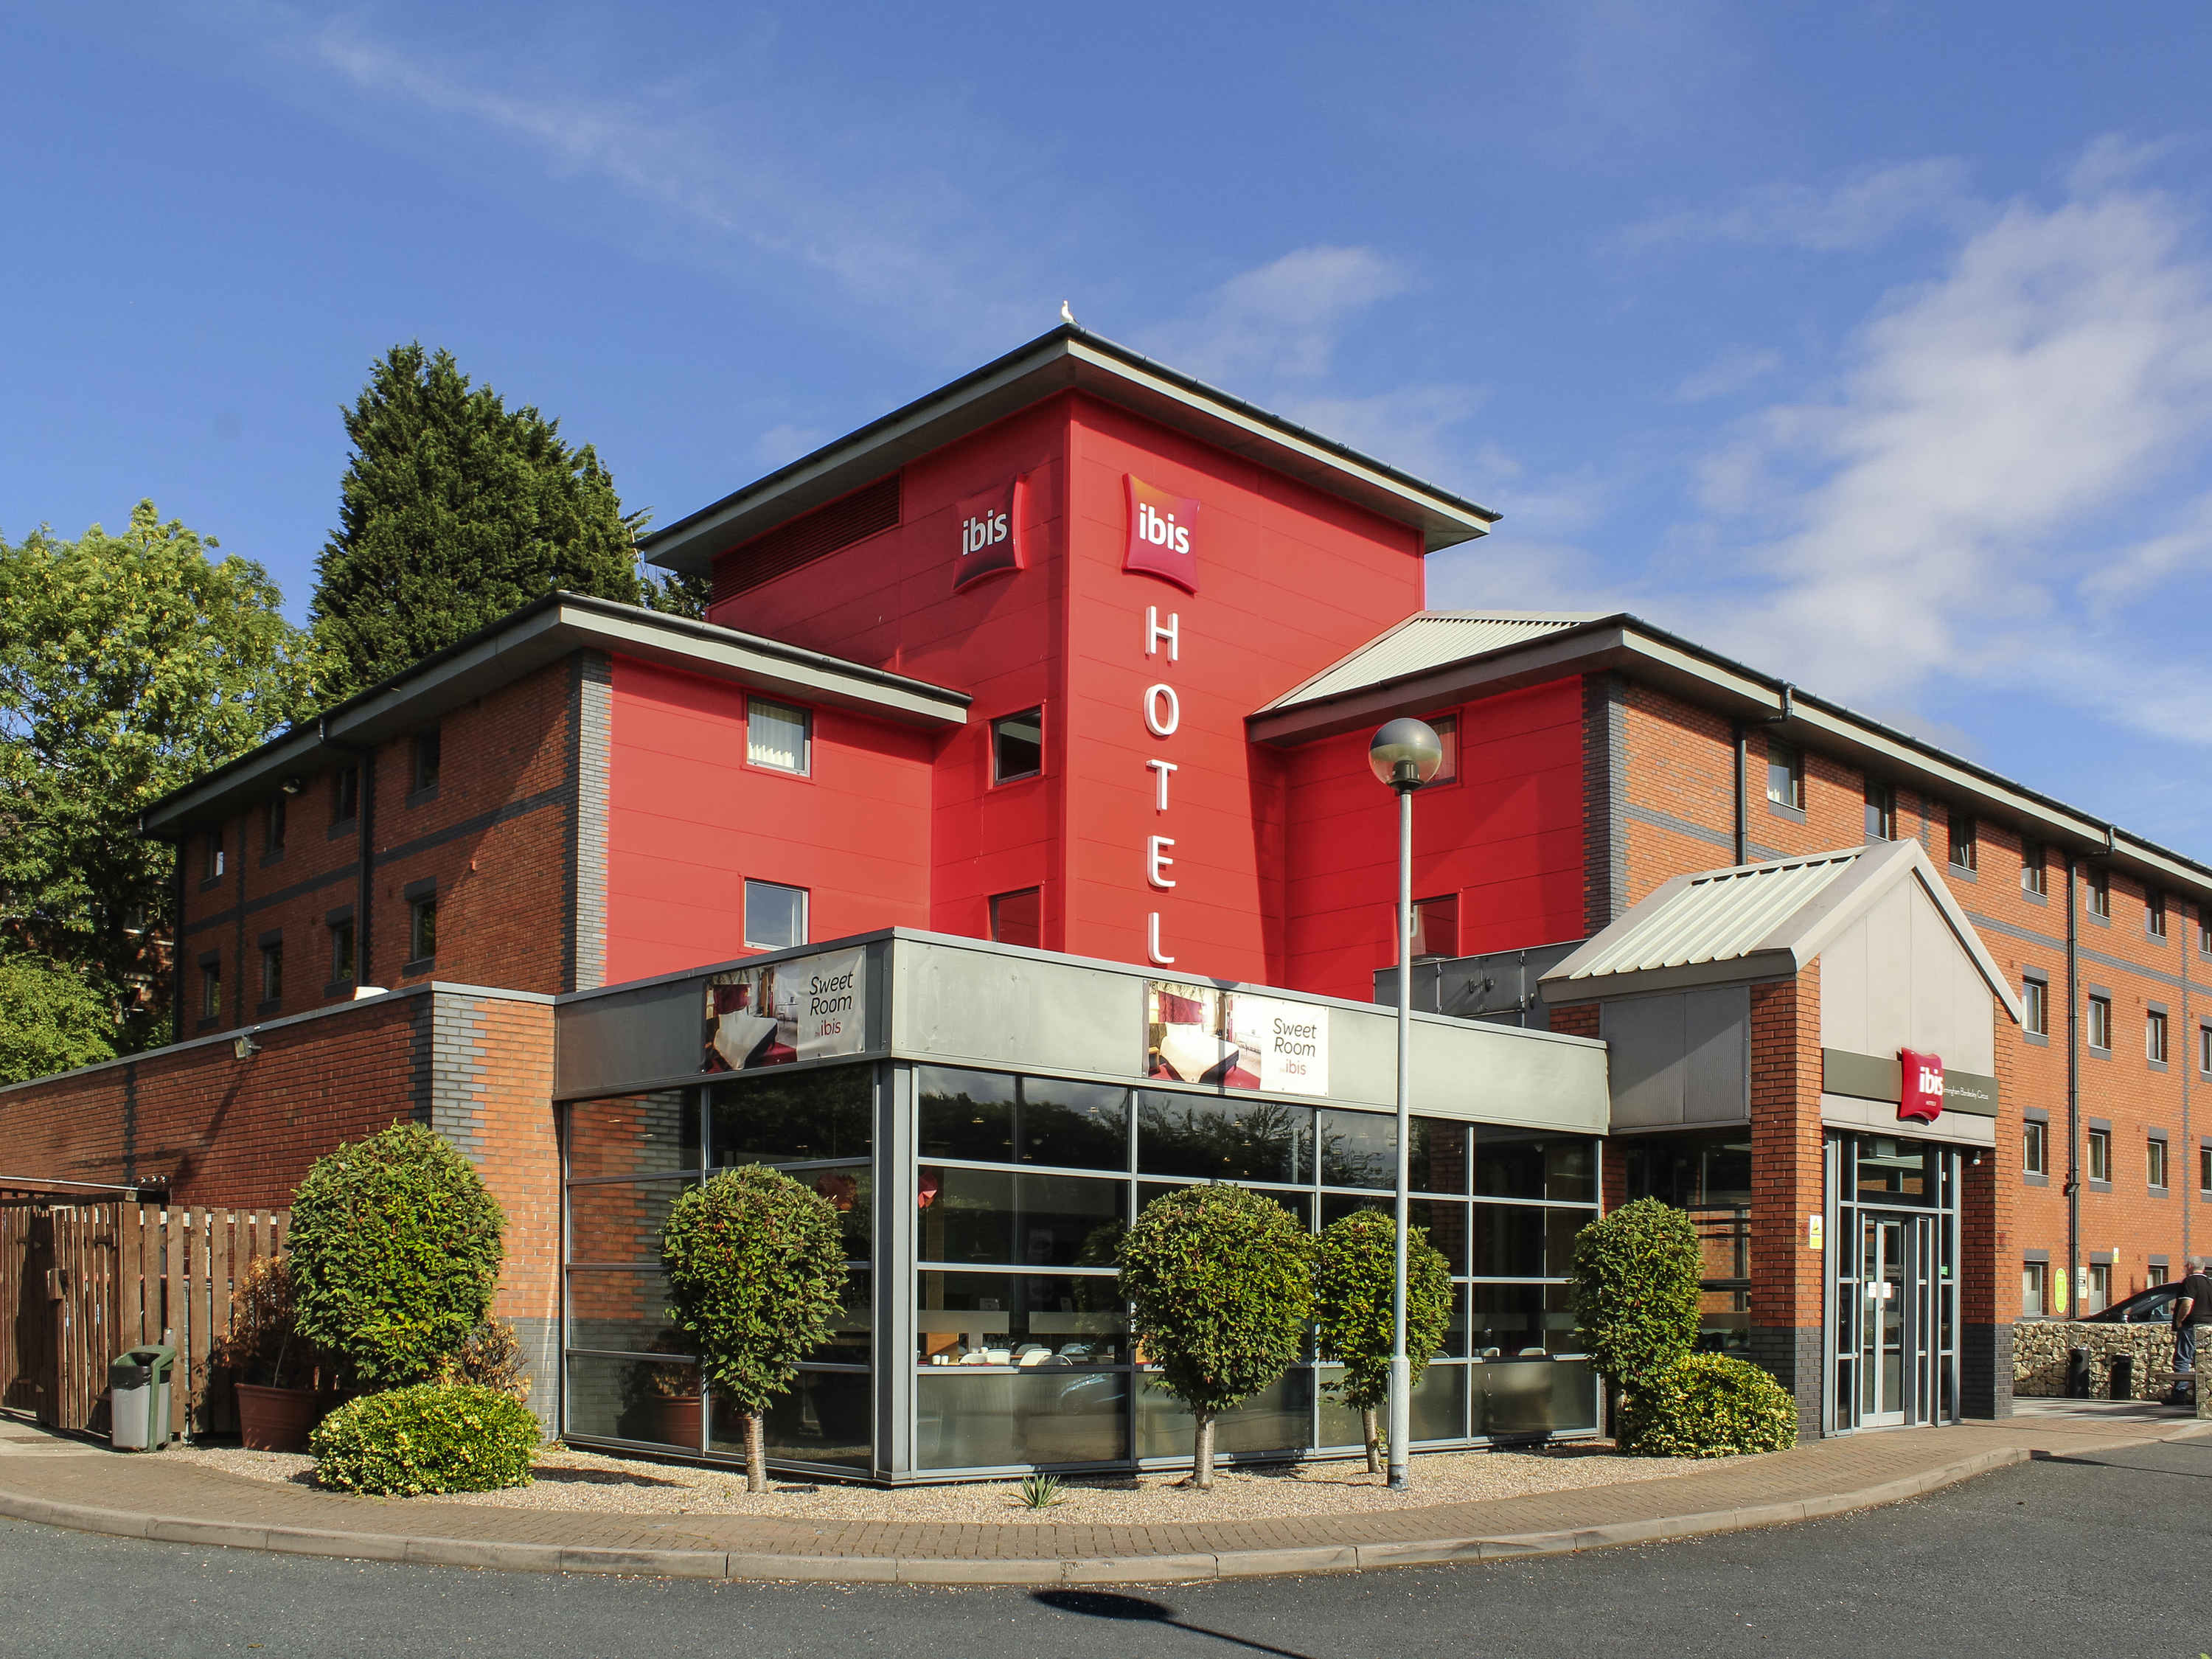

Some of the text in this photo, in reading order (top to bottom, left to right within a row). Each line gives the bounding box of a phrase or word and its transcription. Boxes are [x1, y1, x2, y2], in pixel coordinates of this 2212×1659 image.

[962, 509, 1007, 555] ibis
[1139, 503, 1190, 554] ibis
[1144, 606, 1179, 964] HOTEL
[810, 972, 854, 995] Sweet
[810, 995, 852, 1016] Room
[821, 1018, 841, 1036] ibis
[1273, 1018, 1317, 1039] Sweet
[1274, 1037, 1315, 1057] Room
[1286, 1058, 1307, 1075] ibis
[1919, 1066, 1944, 1096] ibis
